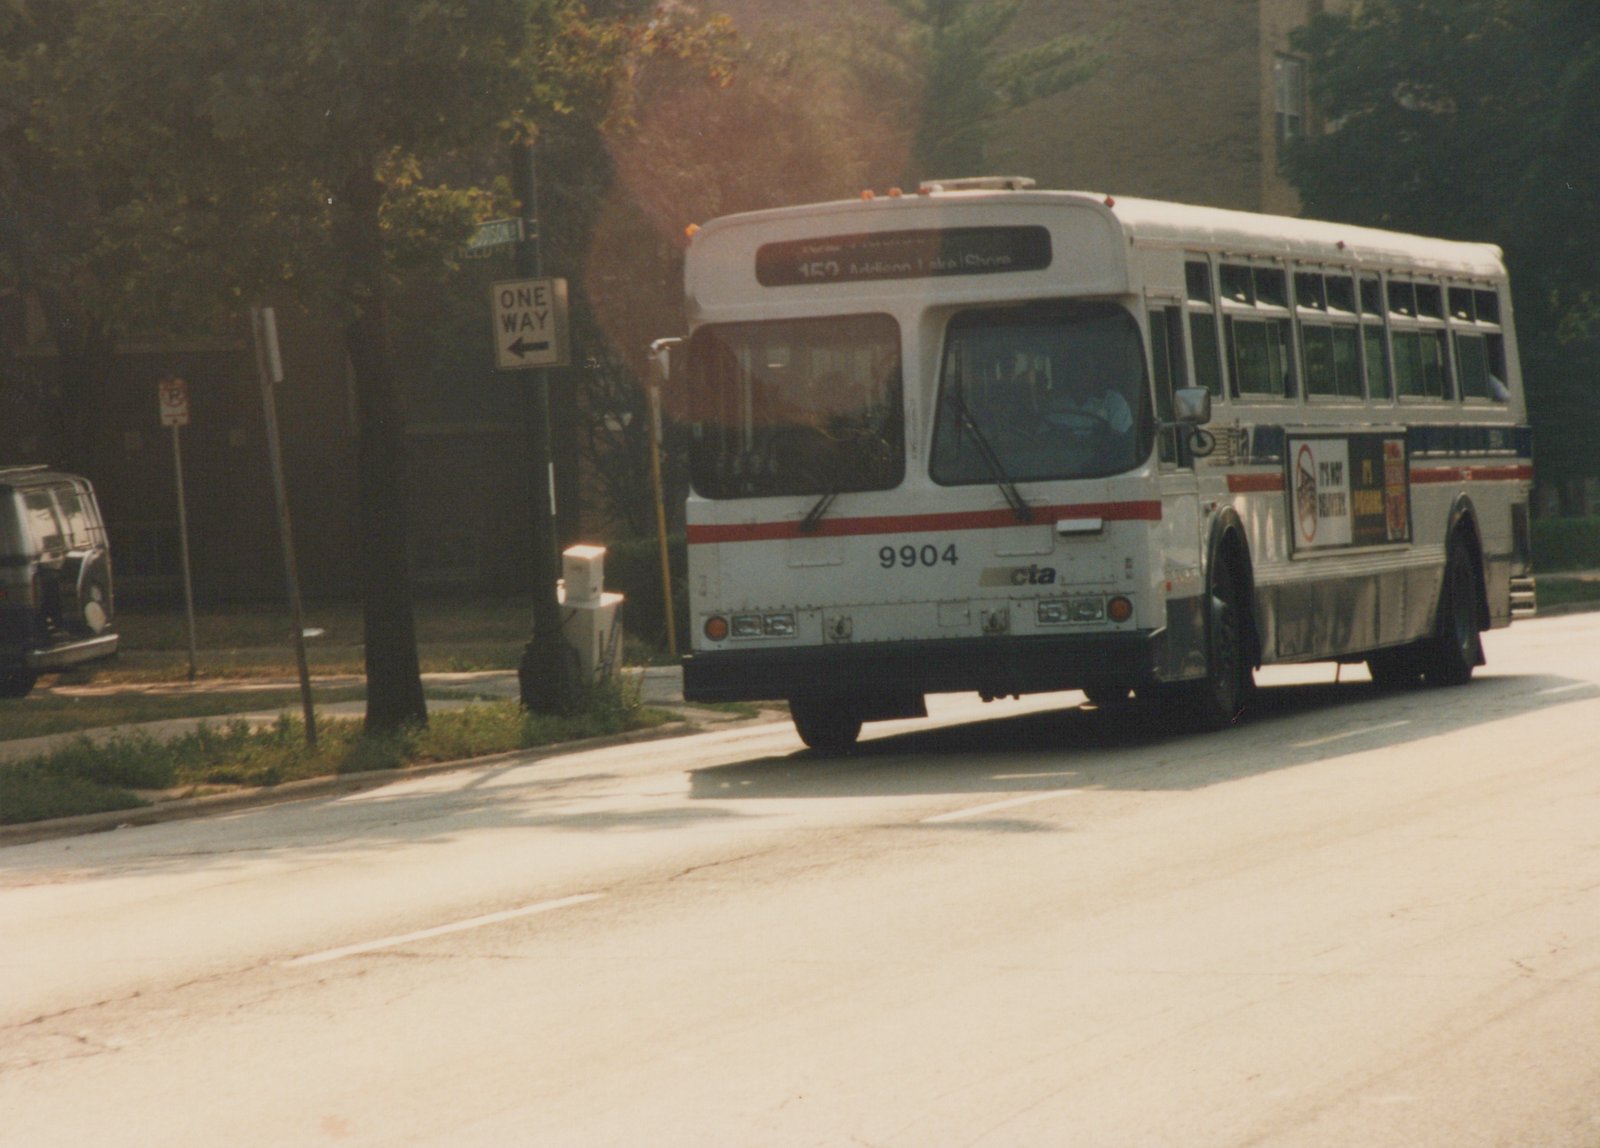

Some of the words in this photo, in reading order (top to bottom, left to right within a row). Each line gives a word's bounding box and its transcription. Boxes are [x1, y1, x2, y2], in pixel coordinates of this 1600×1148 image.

[501, 287, 547, 309] ONE
[501, 311, 549, 333] WAY
[878, 544, 959, 569] 9904
[1009, 564, 1057, 586] cta
